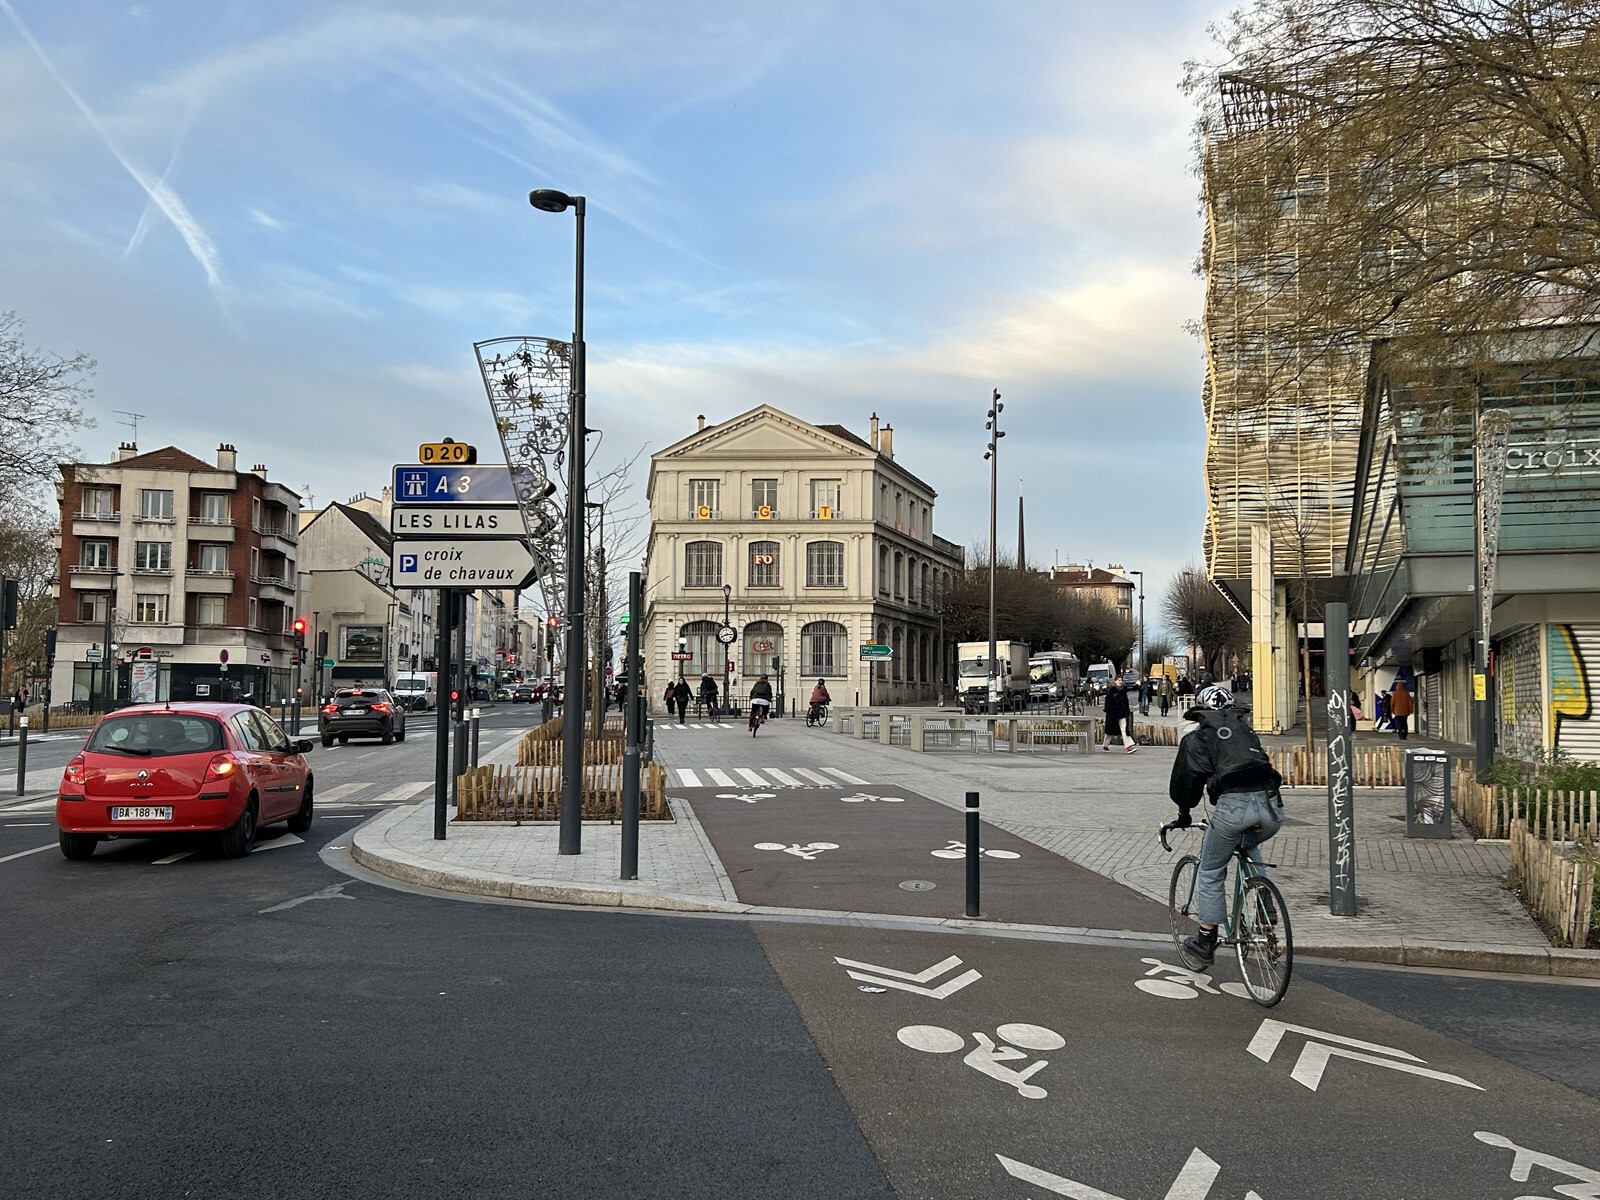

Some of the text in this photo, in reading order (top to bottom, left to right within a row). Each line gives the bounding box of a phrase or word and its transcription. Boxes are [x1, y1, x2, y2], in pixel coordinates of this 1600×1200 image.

[424, 446, 463, 460] D 20
[1505, 443, 1600, 469] Croix
[434, 475, 471, 493] A 3
[399, 514, 498, 529] LES LILAS
[424, 547, 463, 560] croix
[755, 555, 773, 565] FO
[424, 566, 515, 580] de chavaux
[119, 807, 165, 817] BA-188-YN
